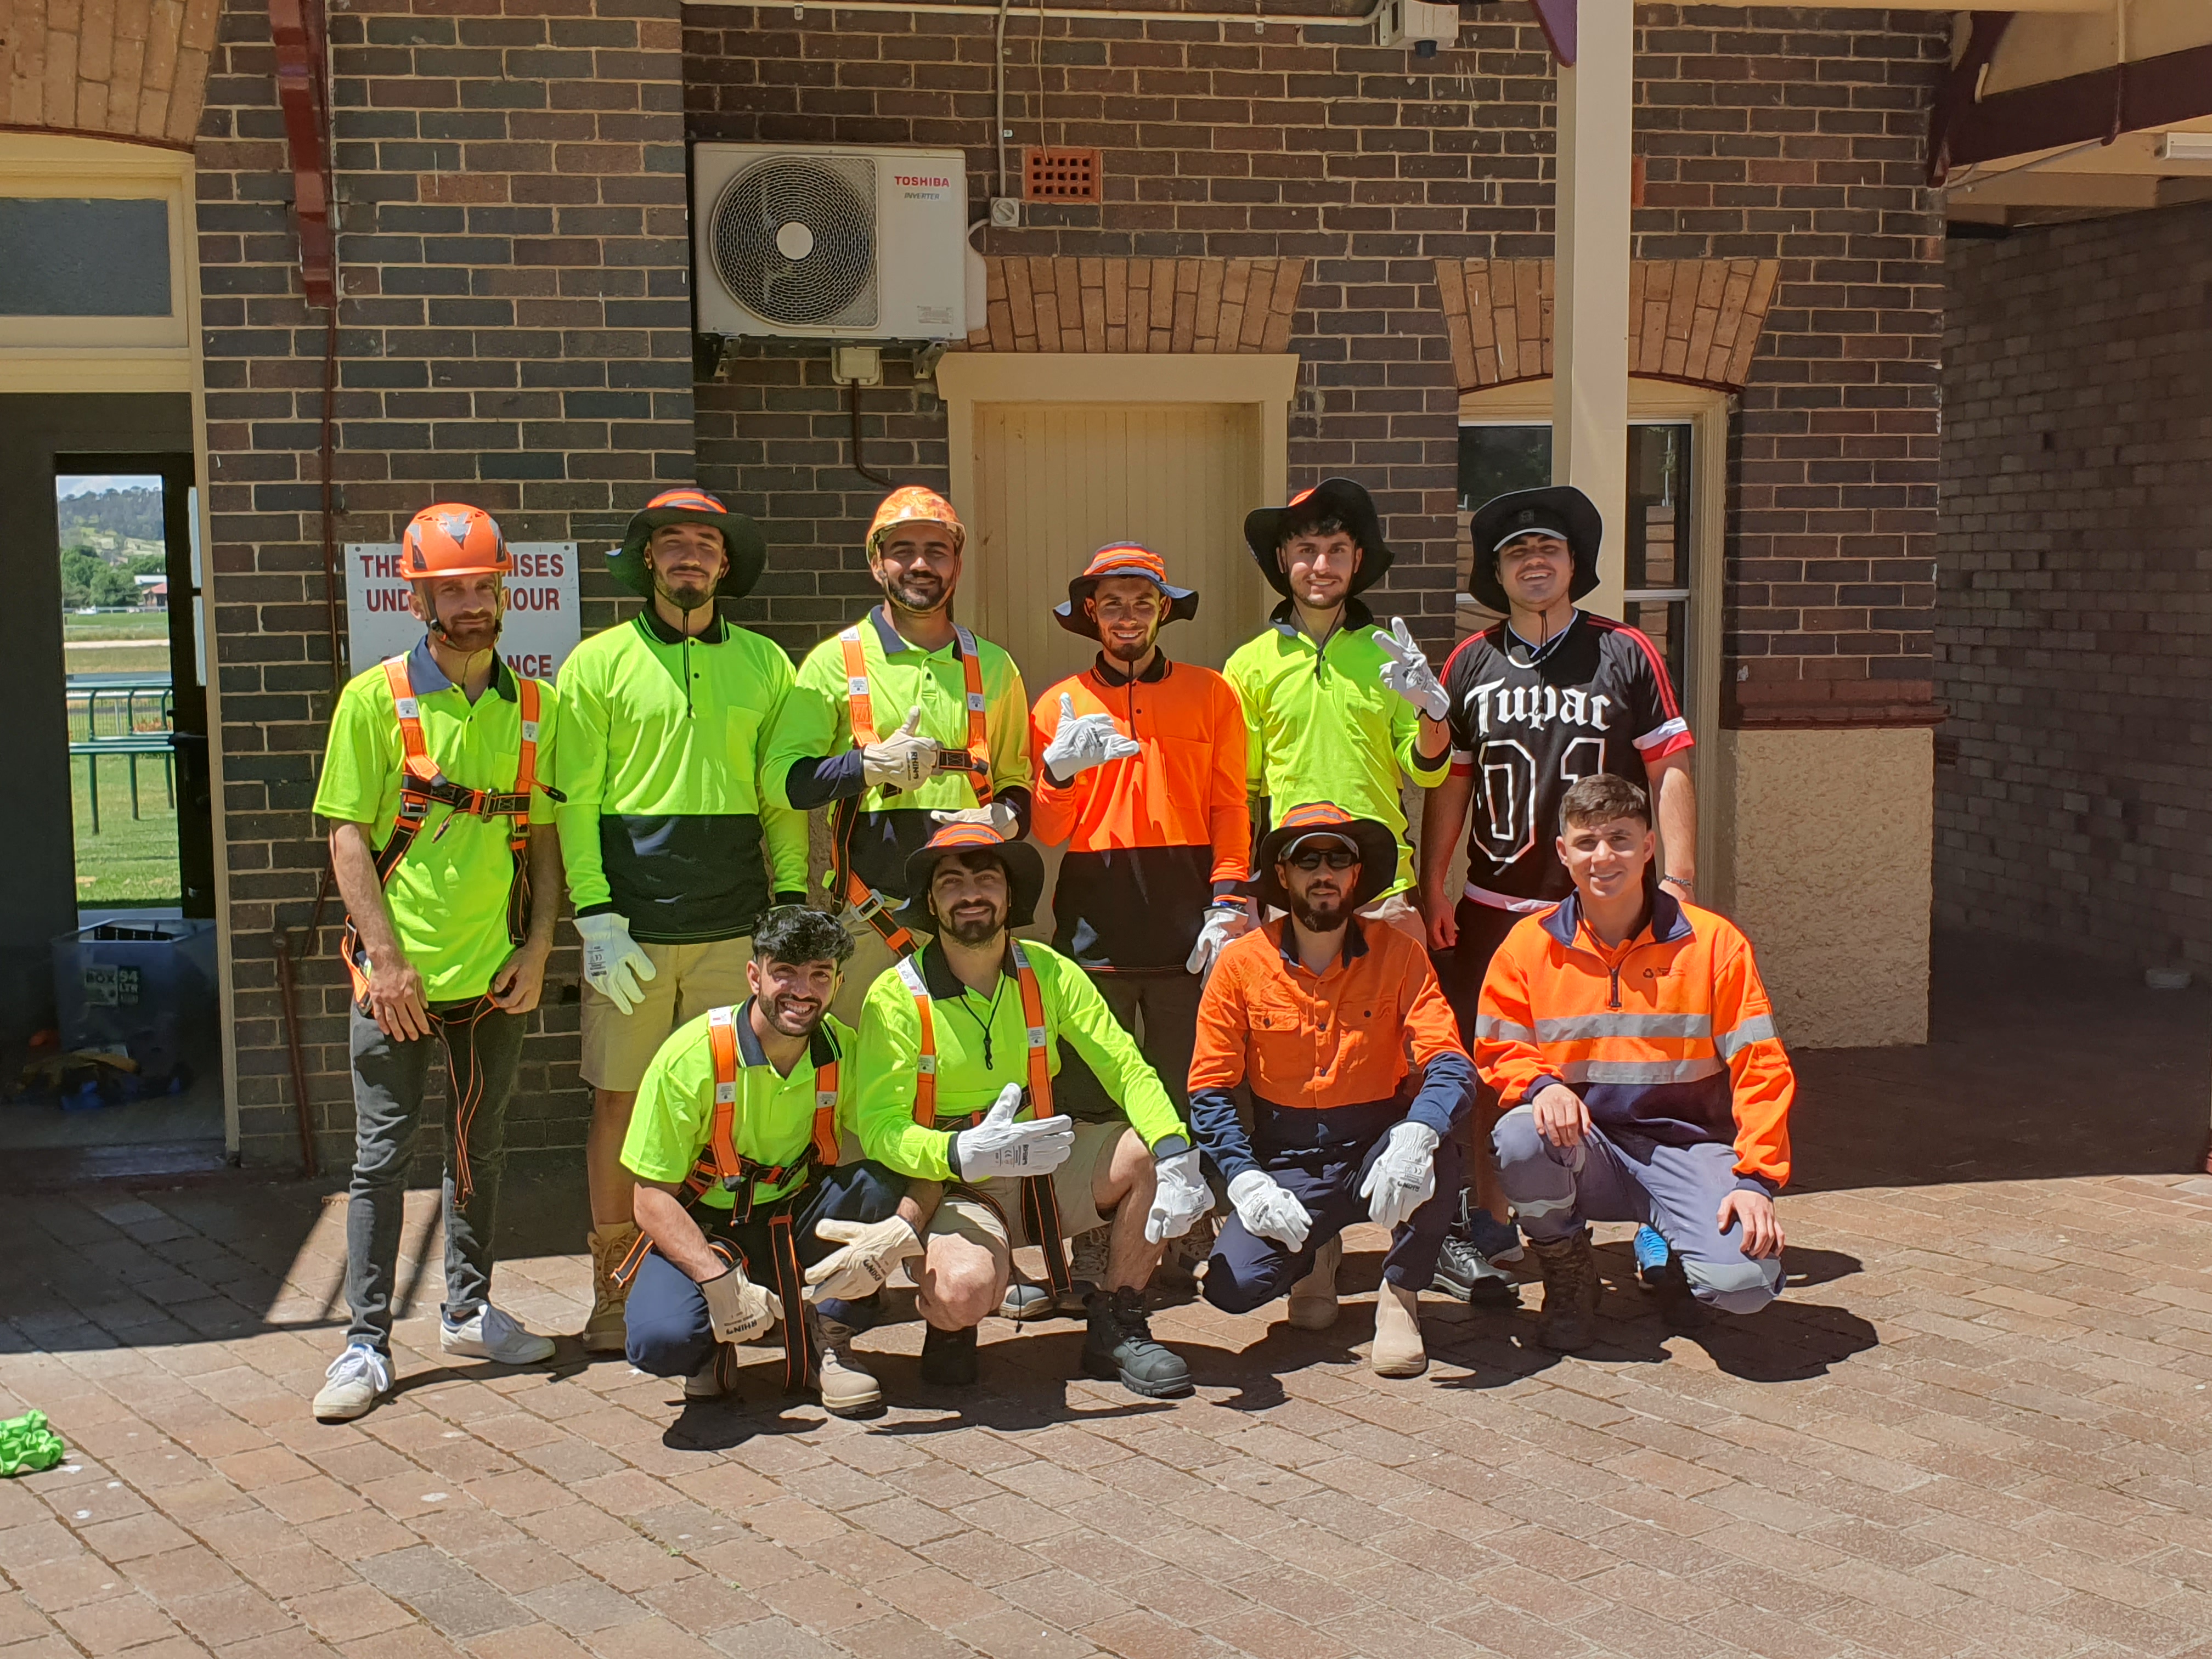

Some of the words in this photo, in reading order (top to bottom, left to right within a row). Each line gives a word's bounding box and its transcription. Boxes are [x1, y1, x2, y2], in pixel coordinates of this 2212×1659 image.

[894, 176, 950, 187] TOSHIBA
[359, 555, 403, 578] THE
[508, 554, 564, 577] ISES
[366, 589, 409, 612] UND
[1464, 677, 1611, 737] Tupac
